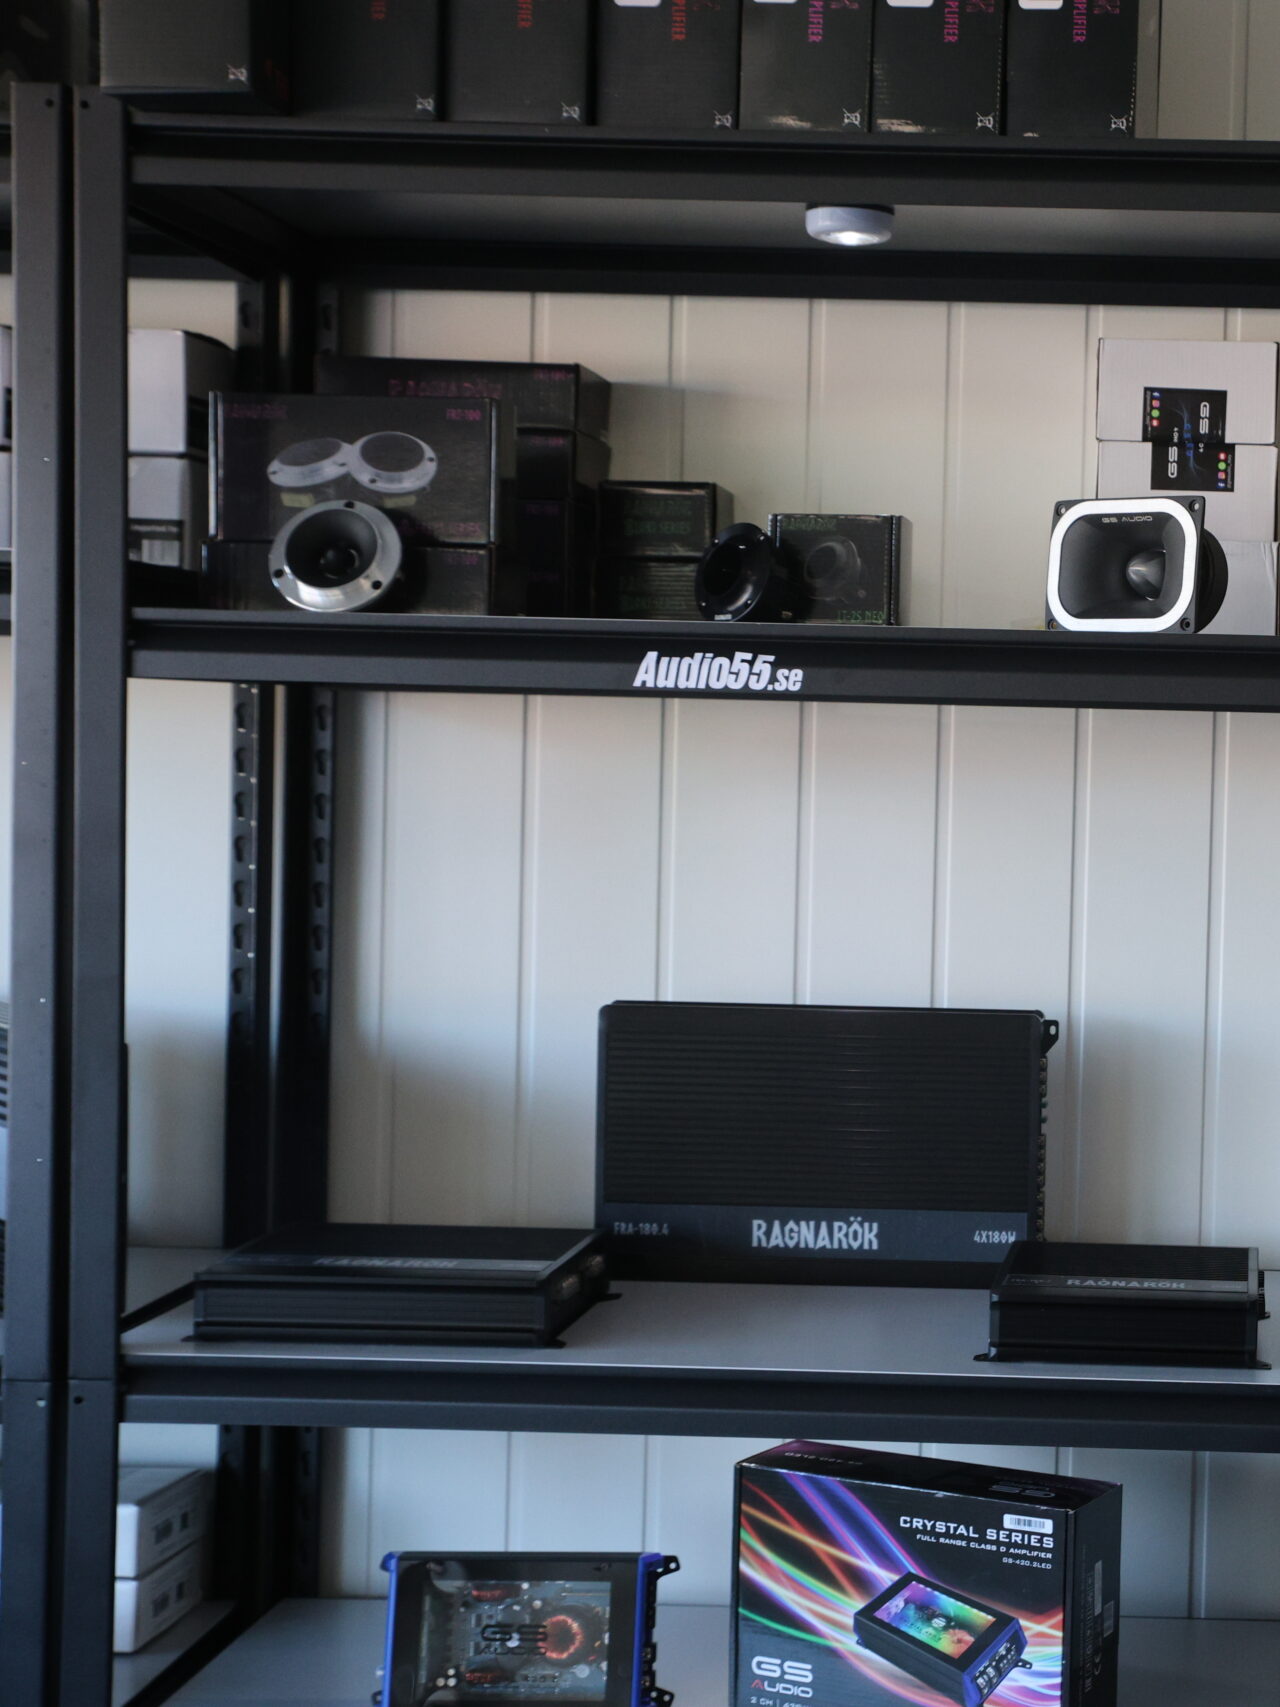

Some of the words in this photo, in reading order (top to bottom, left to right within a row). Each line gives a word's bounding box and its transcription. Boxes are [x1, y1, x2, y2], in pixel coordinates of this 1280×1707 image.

[632, 651, 803, 691] Audio55.se
[752, 1216, 878, 1251] RAGNARÖK
[899, 1515, 979, 1538] CRYSTAL
[986, 1528, 1054, 1549] SERIES
[916, 1533, 937, 1543] FULL
[939, 1537, 968, 1547] RANGE
[969, 1541, 997, 1552] CLASS
[1009, 1547, 1053, 1560] AMPLIFIER
[751, 1655, 813, 1684] GS
[751, 1679, 813, 1699] AUDIO
